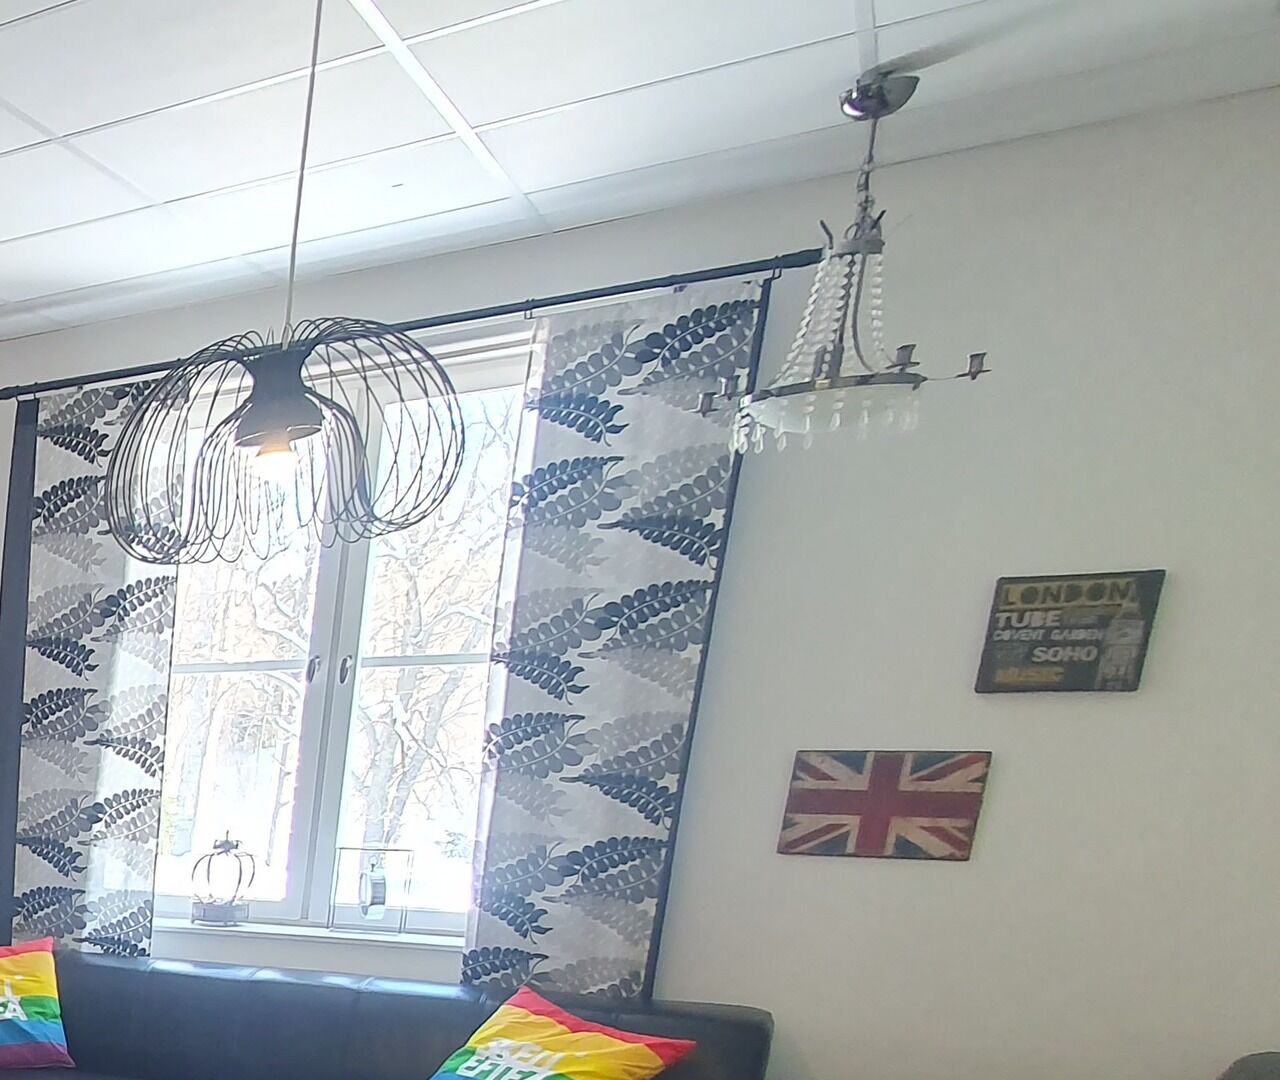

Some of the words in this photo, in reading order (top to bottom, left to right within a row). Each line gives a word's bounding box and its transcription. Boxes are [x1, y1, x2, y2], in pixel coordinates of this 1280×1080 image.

[1004, 580, 1131, 605] LONDON
[994, 610, 1062, 628] TUBE
[1031, 645, 1097, 663] SOHO
